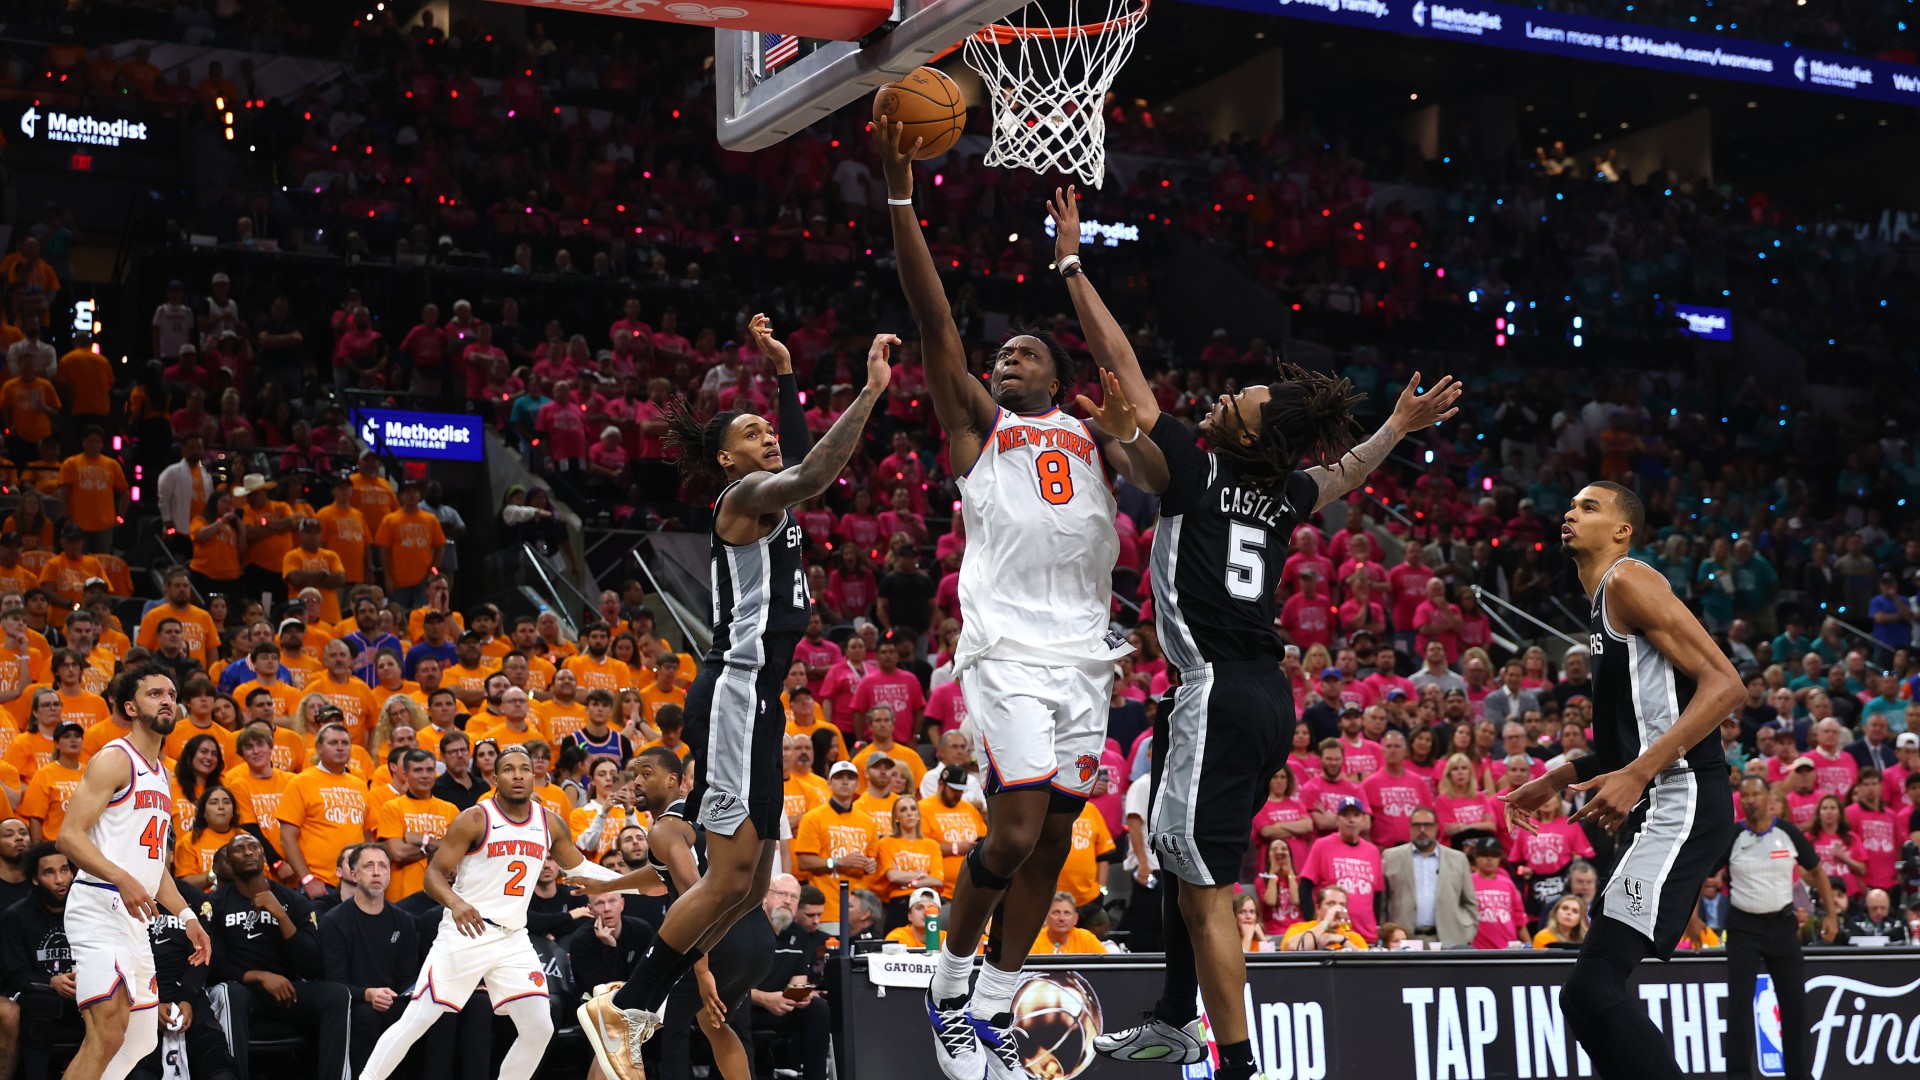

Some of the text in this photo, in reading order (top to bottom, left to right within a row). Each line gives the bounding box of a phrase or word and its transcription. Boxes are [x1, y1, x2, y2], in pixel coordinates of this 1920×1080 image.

[1430, 4, 1502, 30] Methodist
[1525, 20, 1774, 72] Learn more at SAHealth.com/womens
[1810, 60, 1873, 84] Methodist
[48, 112, 147, 140] Methodist
[48, 130, 120, 146] HEALTHCARE
[385, 421, 470, 444] Methodist
[386, 438, 446, 450] HEALTHCARE
[997, 426, 1096, 466] NEW YORK
[1035, 449, 1074, 506] 8
[1220, 486, 1290, 528] CASTLE
[1224, 519, 1267, 602] 5
[320, 792, 366, 812] FINALS
[325, 807, 364, 824] GO GO
[487, 840, 544, 860] NEW YORK
[504, 860, 528, 896] 2
[928, 920, 937, 932] G
[1402, 986, 1498, 1080] TAP
[1638, 982, 1729, 1074] THE
[1188, 1062, 1210, 1079] NBA
[1762, 1052, 1782, 1070] NBA
